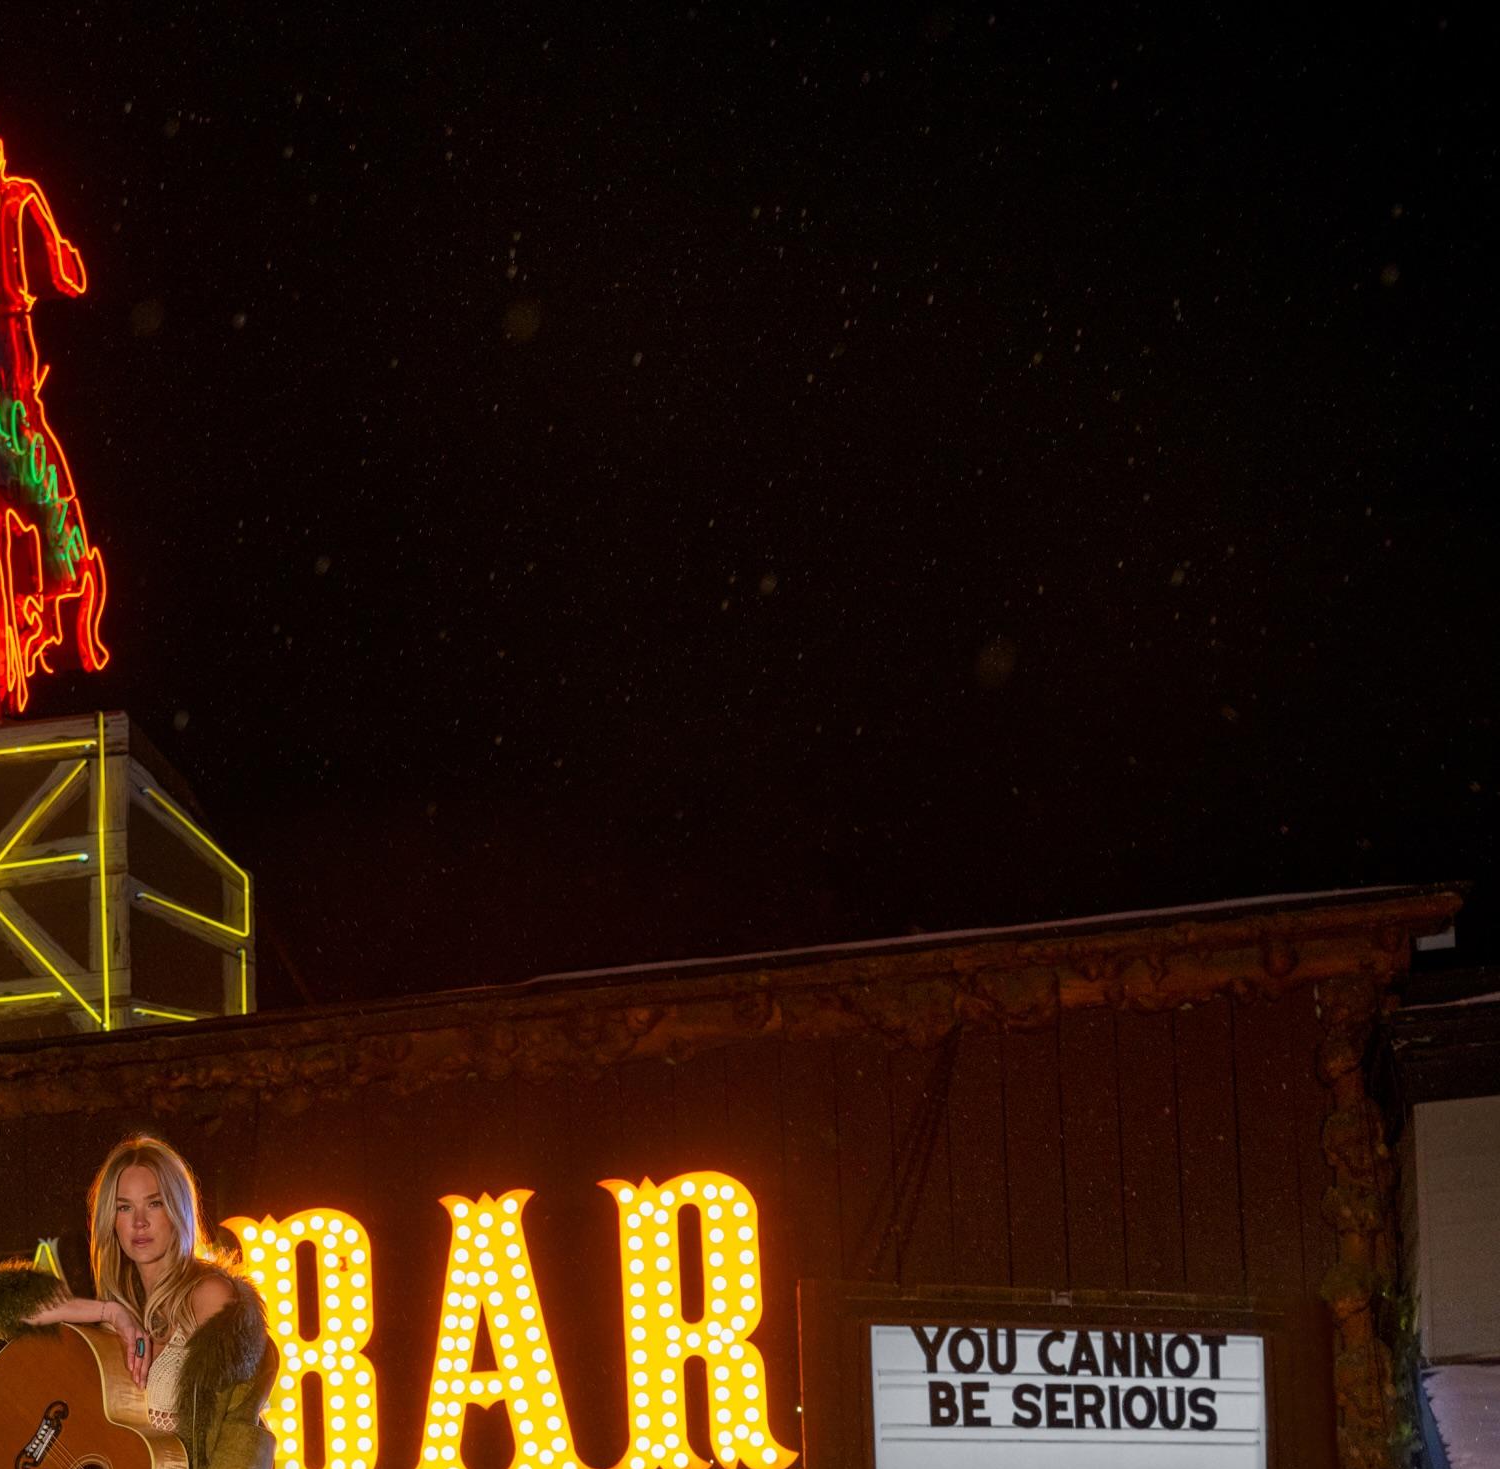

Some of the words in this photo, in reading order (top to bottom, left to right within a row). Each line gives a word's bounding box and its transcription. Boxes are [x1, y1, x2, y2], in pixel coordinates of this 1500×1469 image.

[911, 1326, 1018, 1376] YOU
[1037, 1329, 1228, 1381] CANNOT
[927, 1380, 992, 1428] BE
[1011, 1383, 1219, 1432] SERIOUS
